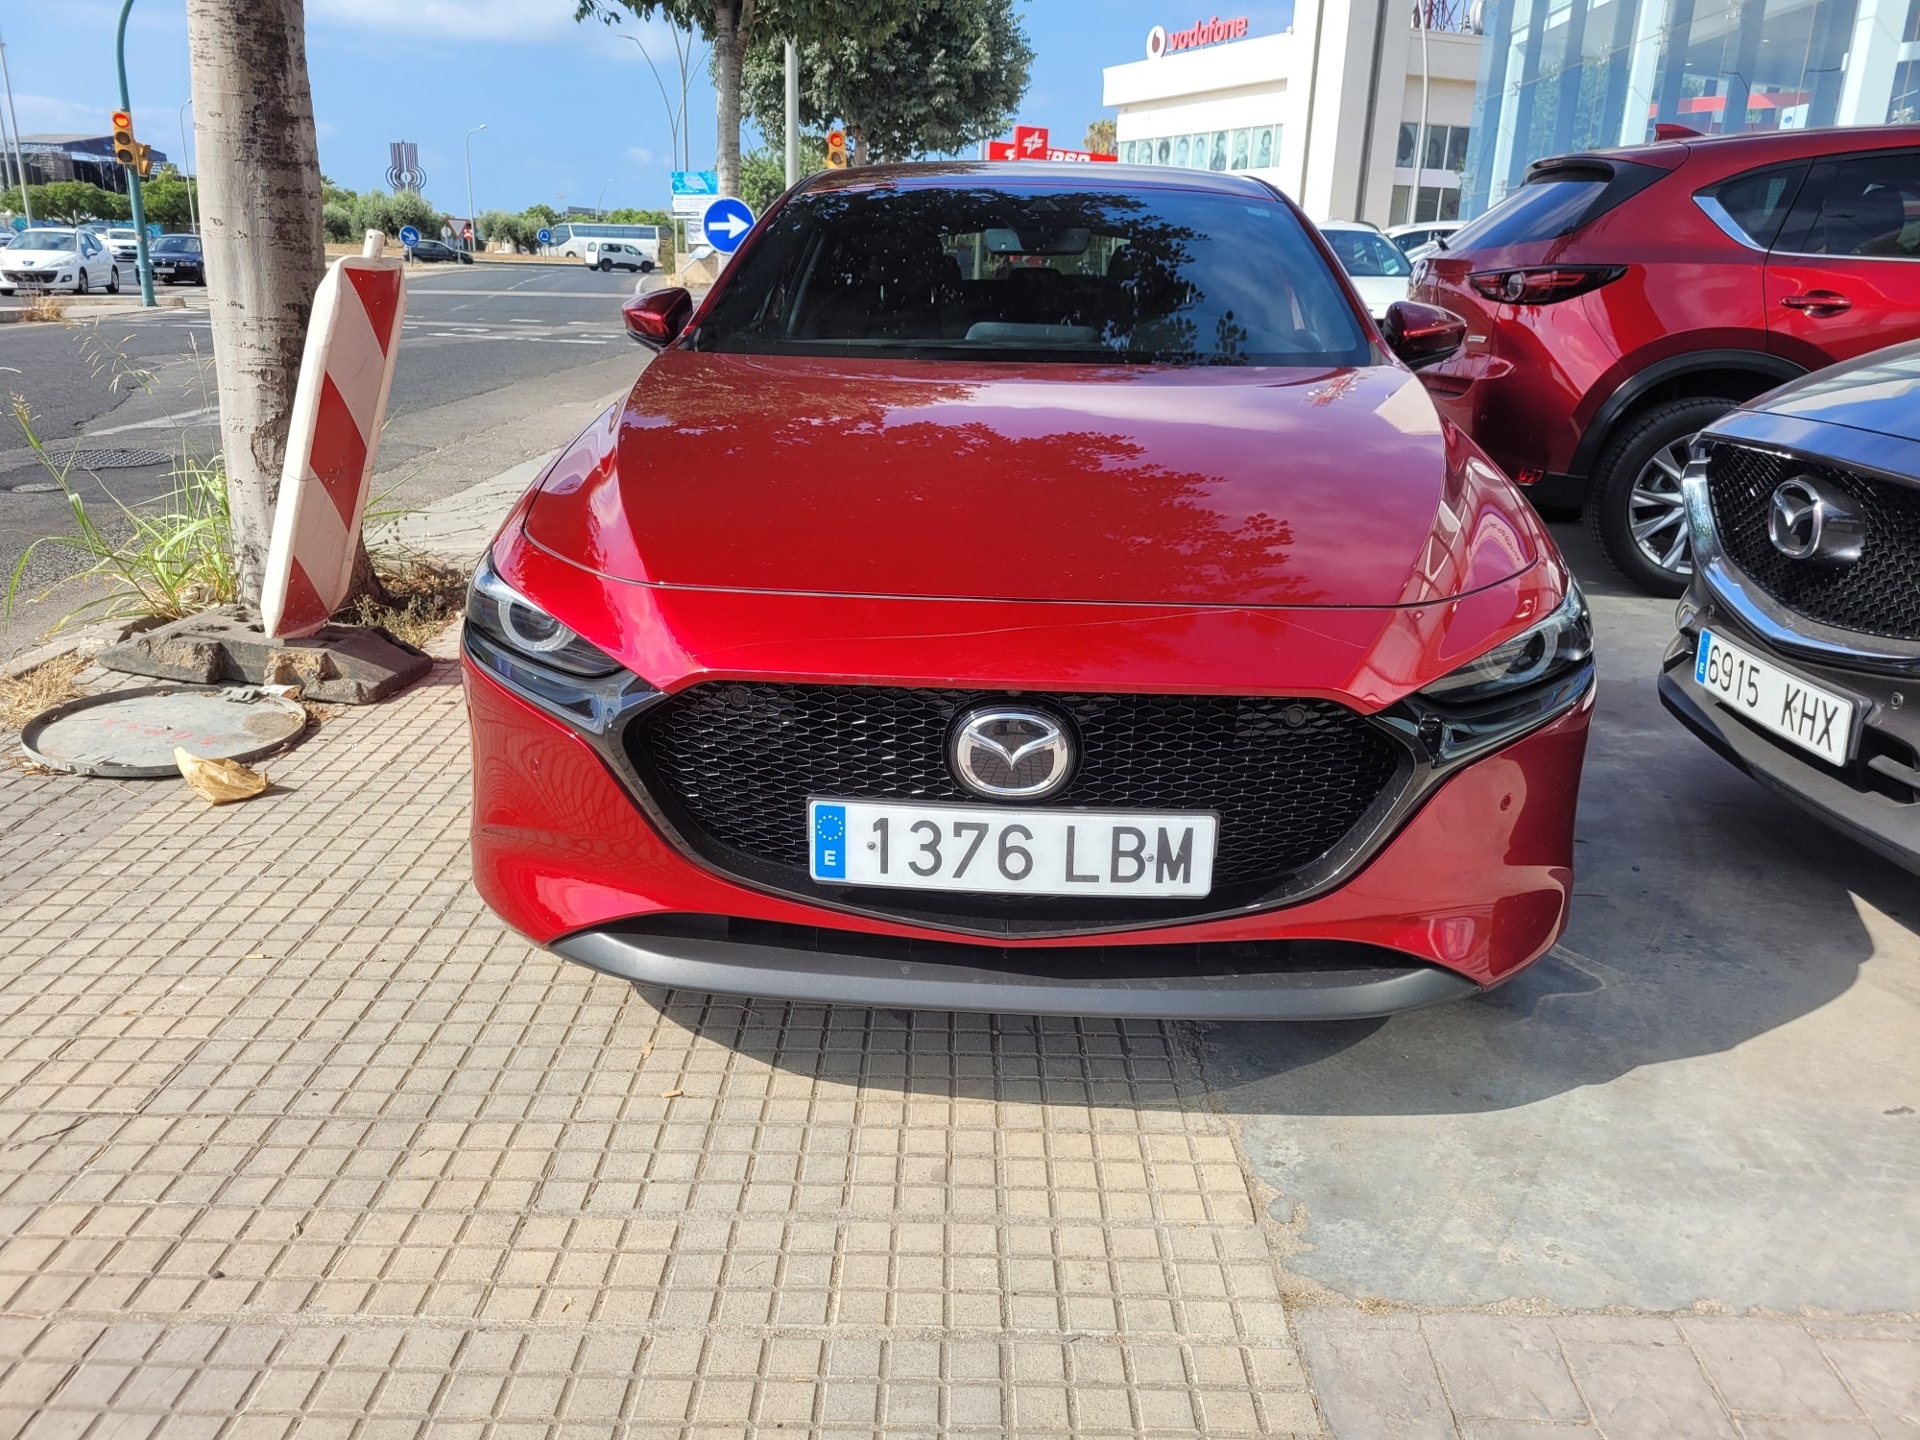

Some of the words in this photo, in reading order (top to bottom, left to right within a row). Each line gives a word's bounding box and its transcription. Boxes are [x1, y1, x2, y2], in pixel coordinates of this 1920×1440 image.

[1168, 16, 1248, 51] vodafone
[1708, 644, 1760, 708] 6915
[1781, 683, 1839, 752] KHX
[824, 850, 836, 866] E
[872, 817, 1034, 881] 1376
[1065, 825, 1194, 884] LBM
